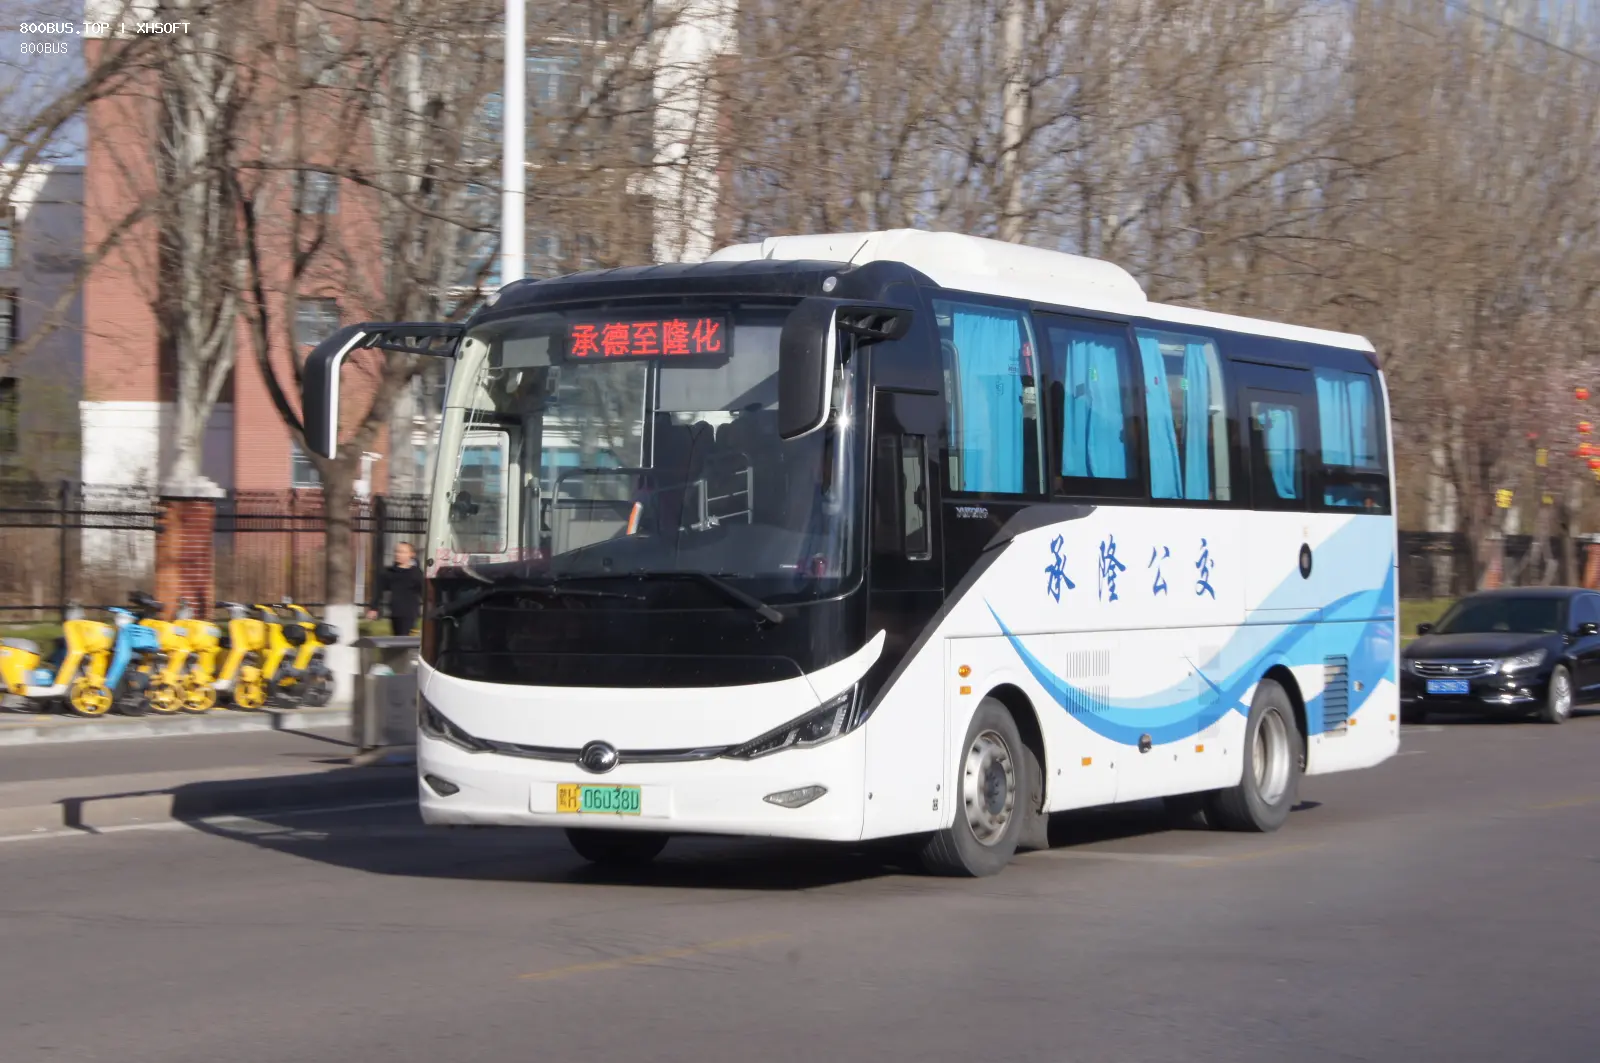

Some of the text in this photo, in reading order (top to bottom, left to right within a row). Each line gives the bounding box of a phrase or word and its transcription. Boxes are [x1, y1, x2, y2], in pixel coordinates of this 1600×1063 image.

[571, 317, 721, 357] 承德至隆化
[1045, 533, 1216, 604] 承隆公交
